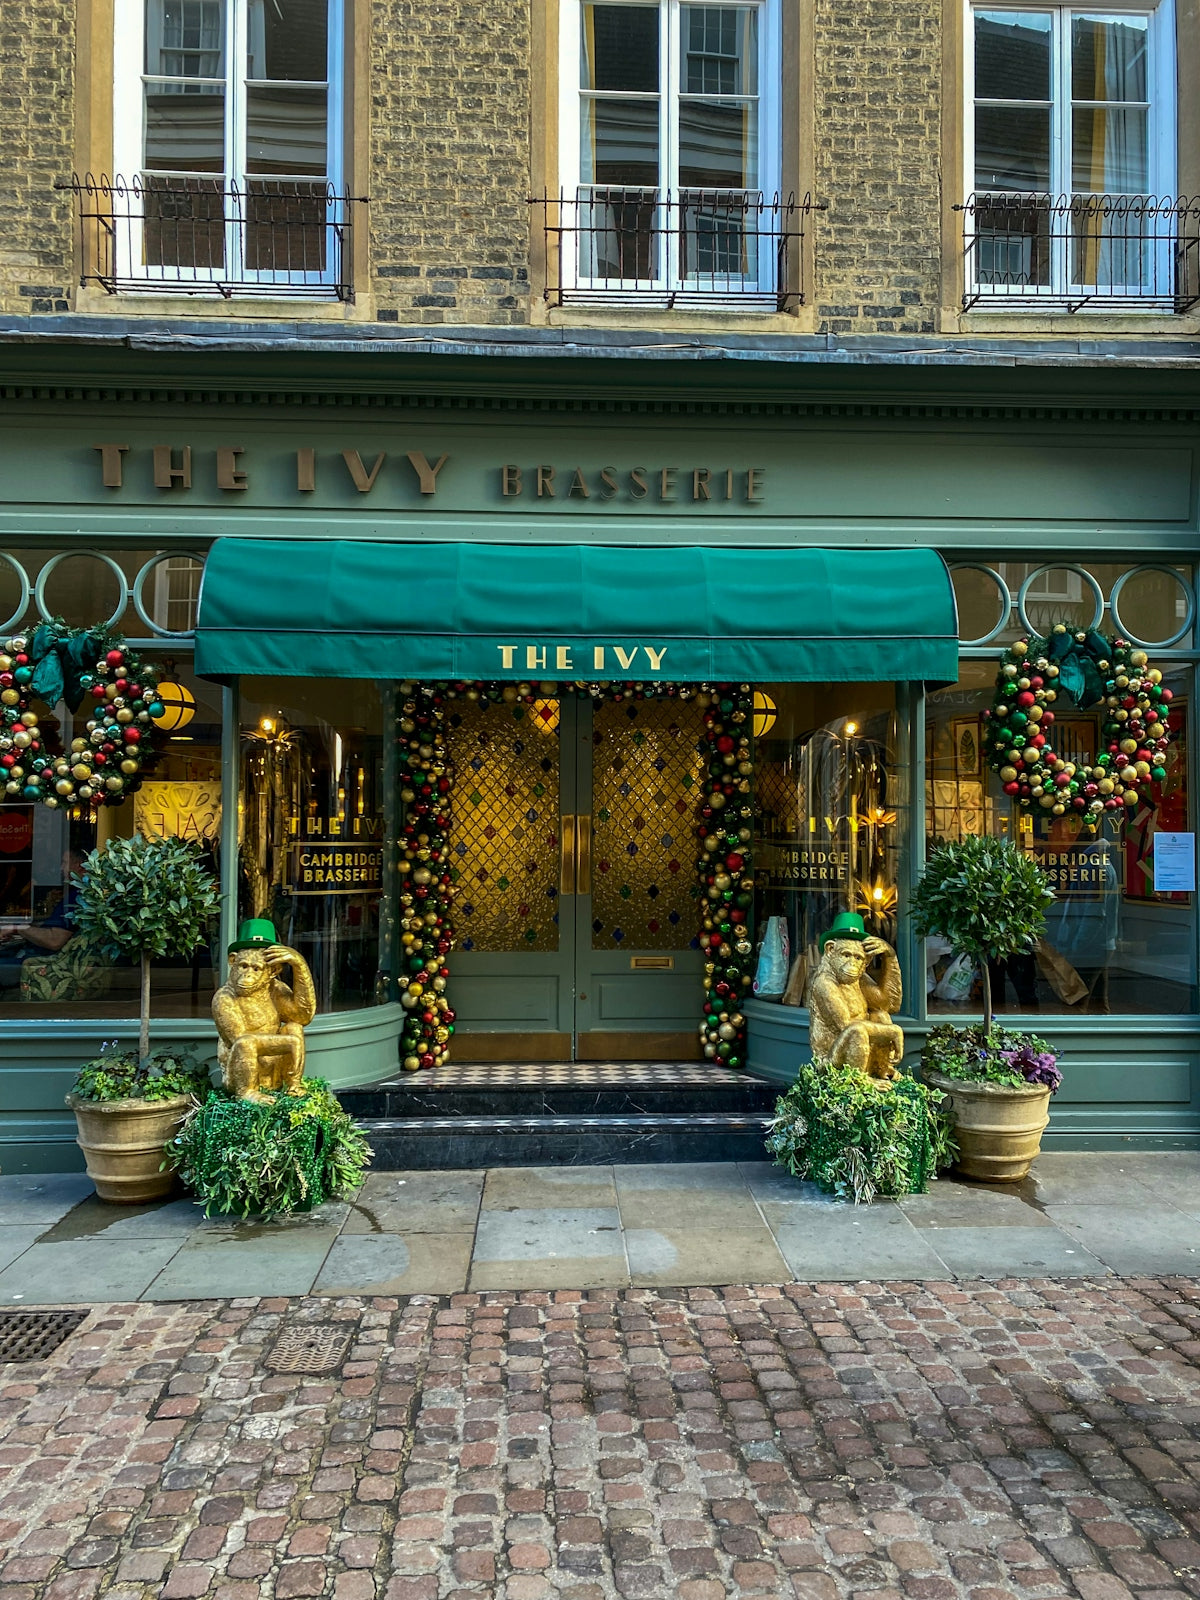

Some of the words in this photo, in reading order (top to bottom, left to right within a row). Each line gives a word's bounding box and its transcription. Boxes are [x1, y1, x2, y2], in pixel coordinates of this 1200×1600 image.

[93, 444, 248, 490] THE
[296, 448, 449, 494] IVY
[501, 464, 766, 501] BRASSERIE
[497, 645, 573, 669] THE
[594, 646, 668, 670] IVY
[285, 817, 341, 835] THE
[809, 817, 862, 833] IVY
[999, 817, 1054, 833] THE
[300, 853, 382, 867] CAMBRIDGE
[779, 851, 849, 865] MBRIDGE
[1032, 852, 1111, 866] MBRIDGE
[303, 868, 380, 883] BRASSERIE
